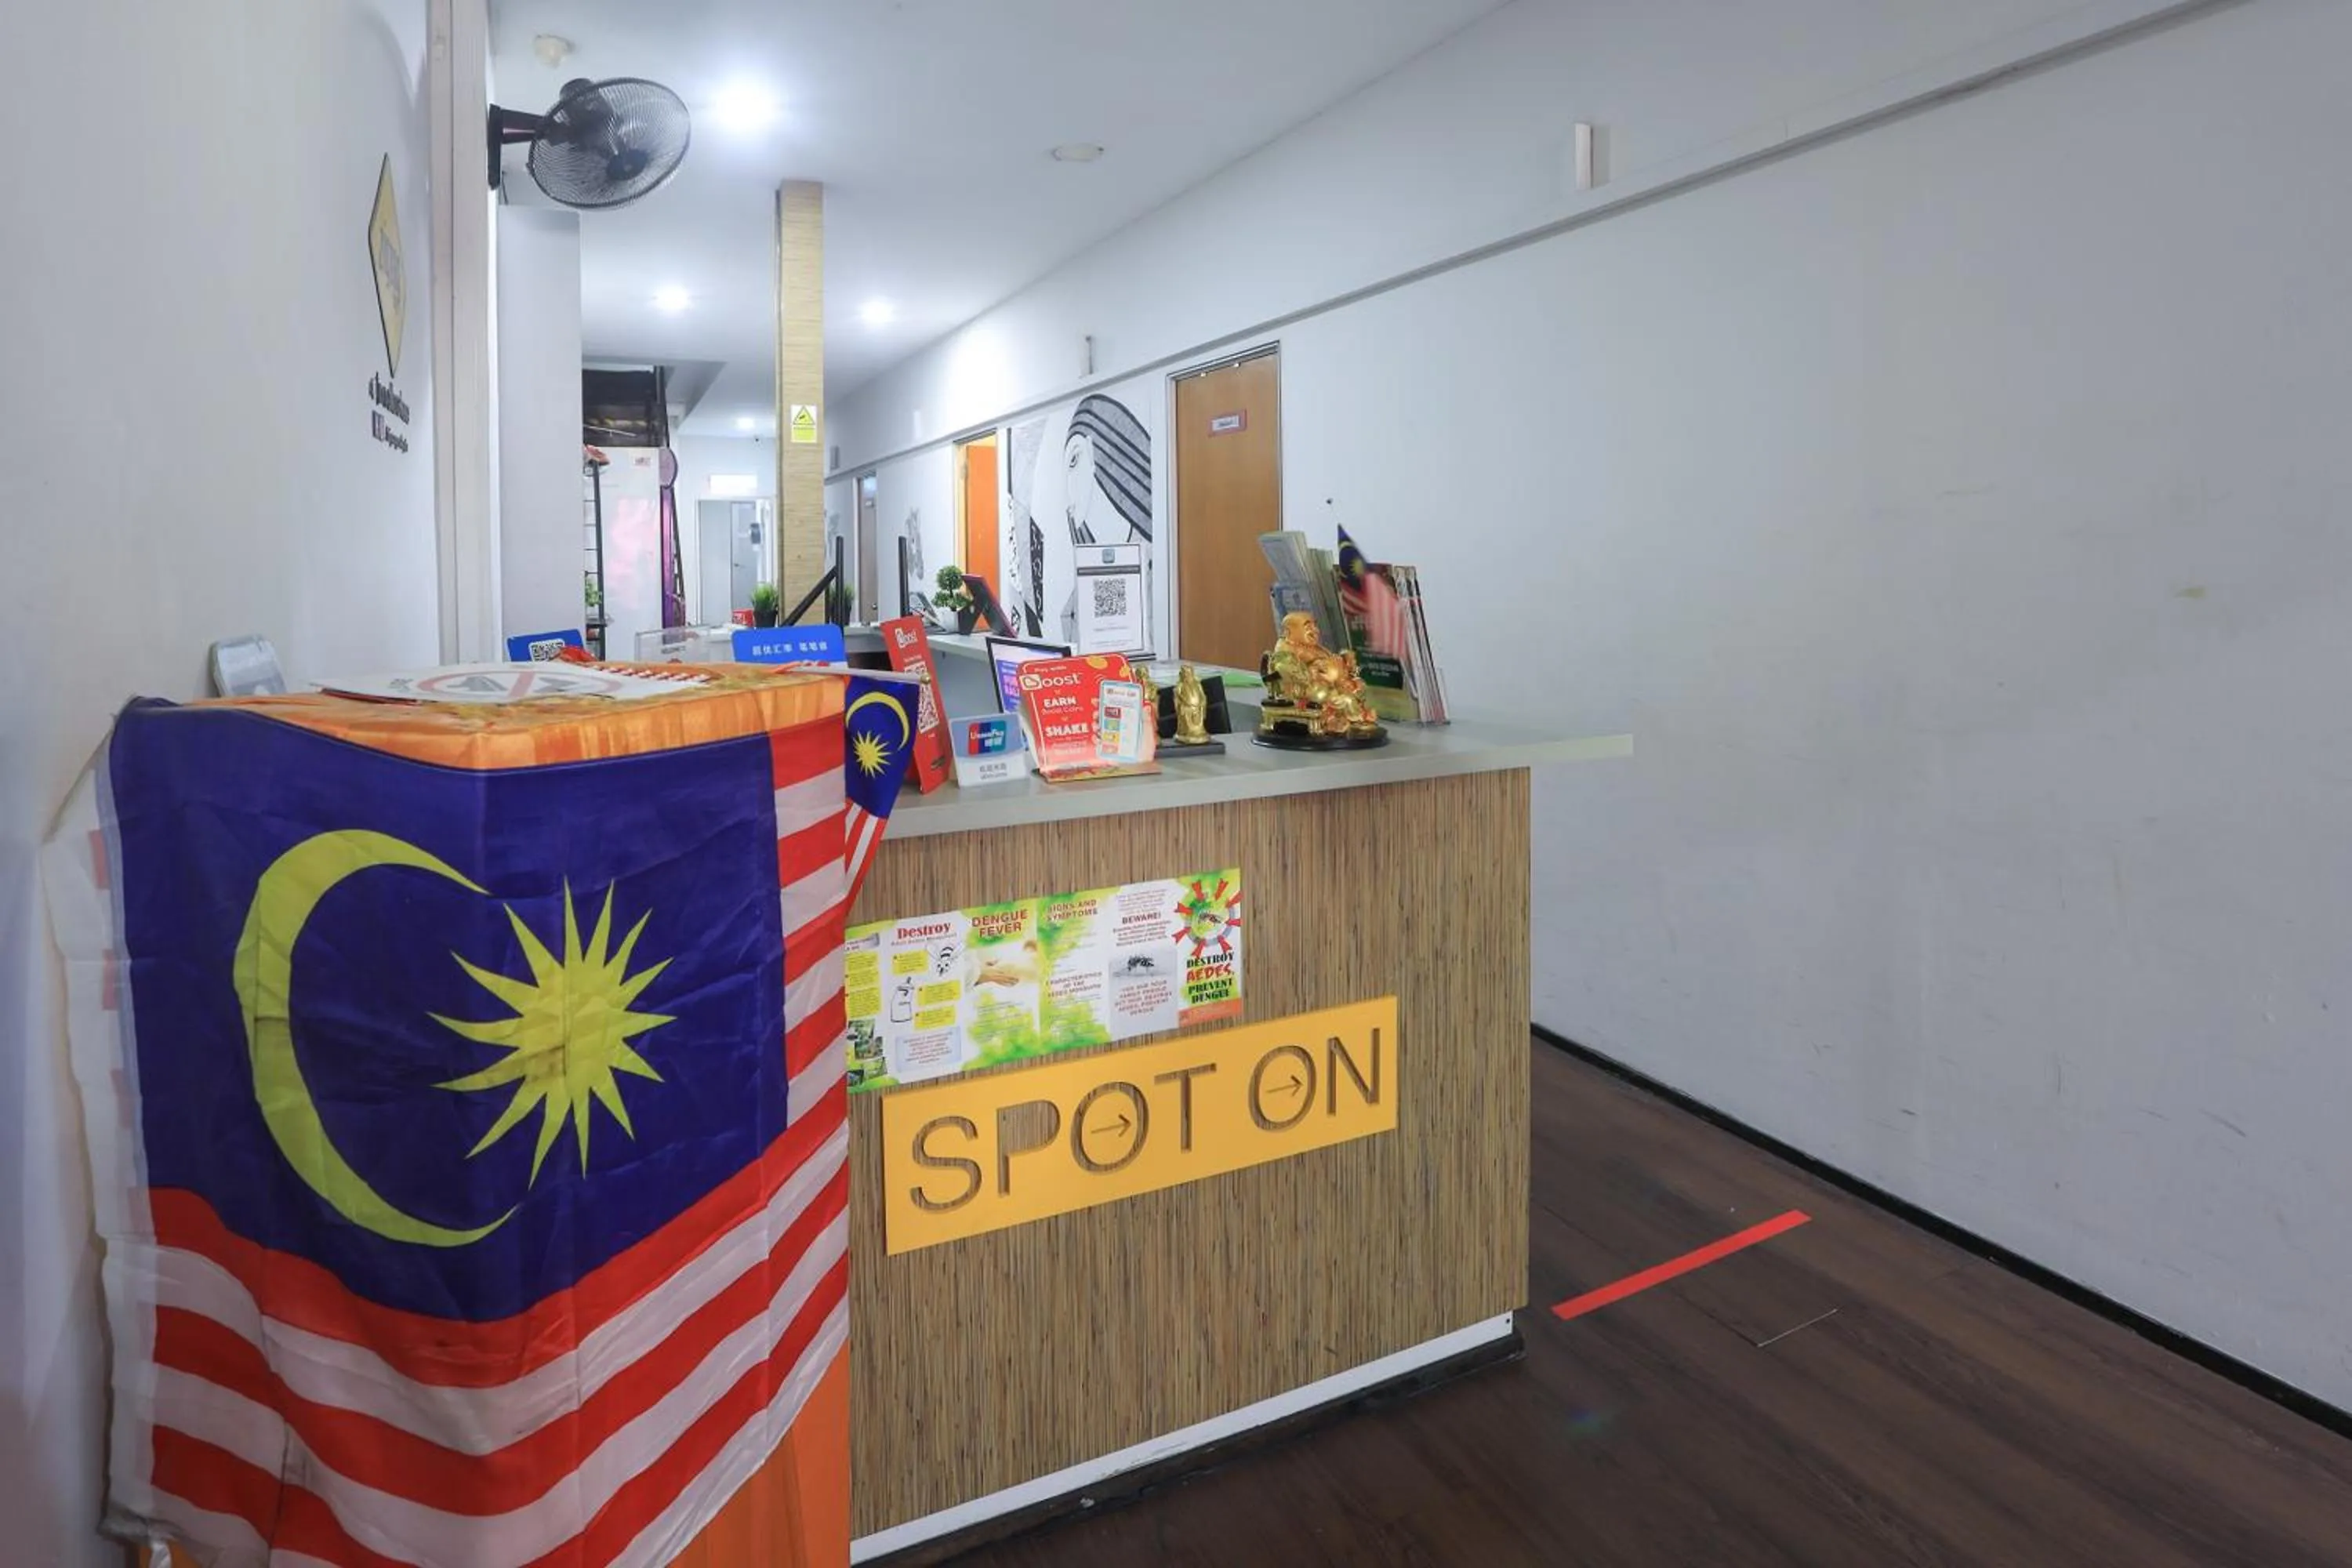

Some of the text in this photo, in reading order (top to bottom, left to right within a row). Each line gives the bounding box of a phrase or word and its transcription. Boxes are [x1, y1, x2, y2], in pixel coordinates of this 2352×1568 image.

[1044, 696, 1076, 707] EARN
[1046, 722, 1089, 737] SHAKE
[972, 909, 1028, 927] DENGUE
[1122, 911, 1161, 924] BEWARE!
[896, 922, 952, 940] Destroy
[979, 921, 1022, 937] FEVER
[1187, 951, 1234, 968] DESTROY
[1189, 978, 1232, 995] PREVENT
[1192, 989, 1229, 1004] DENGUE
[909, 1028, 1381, 1213] SPOT ON
